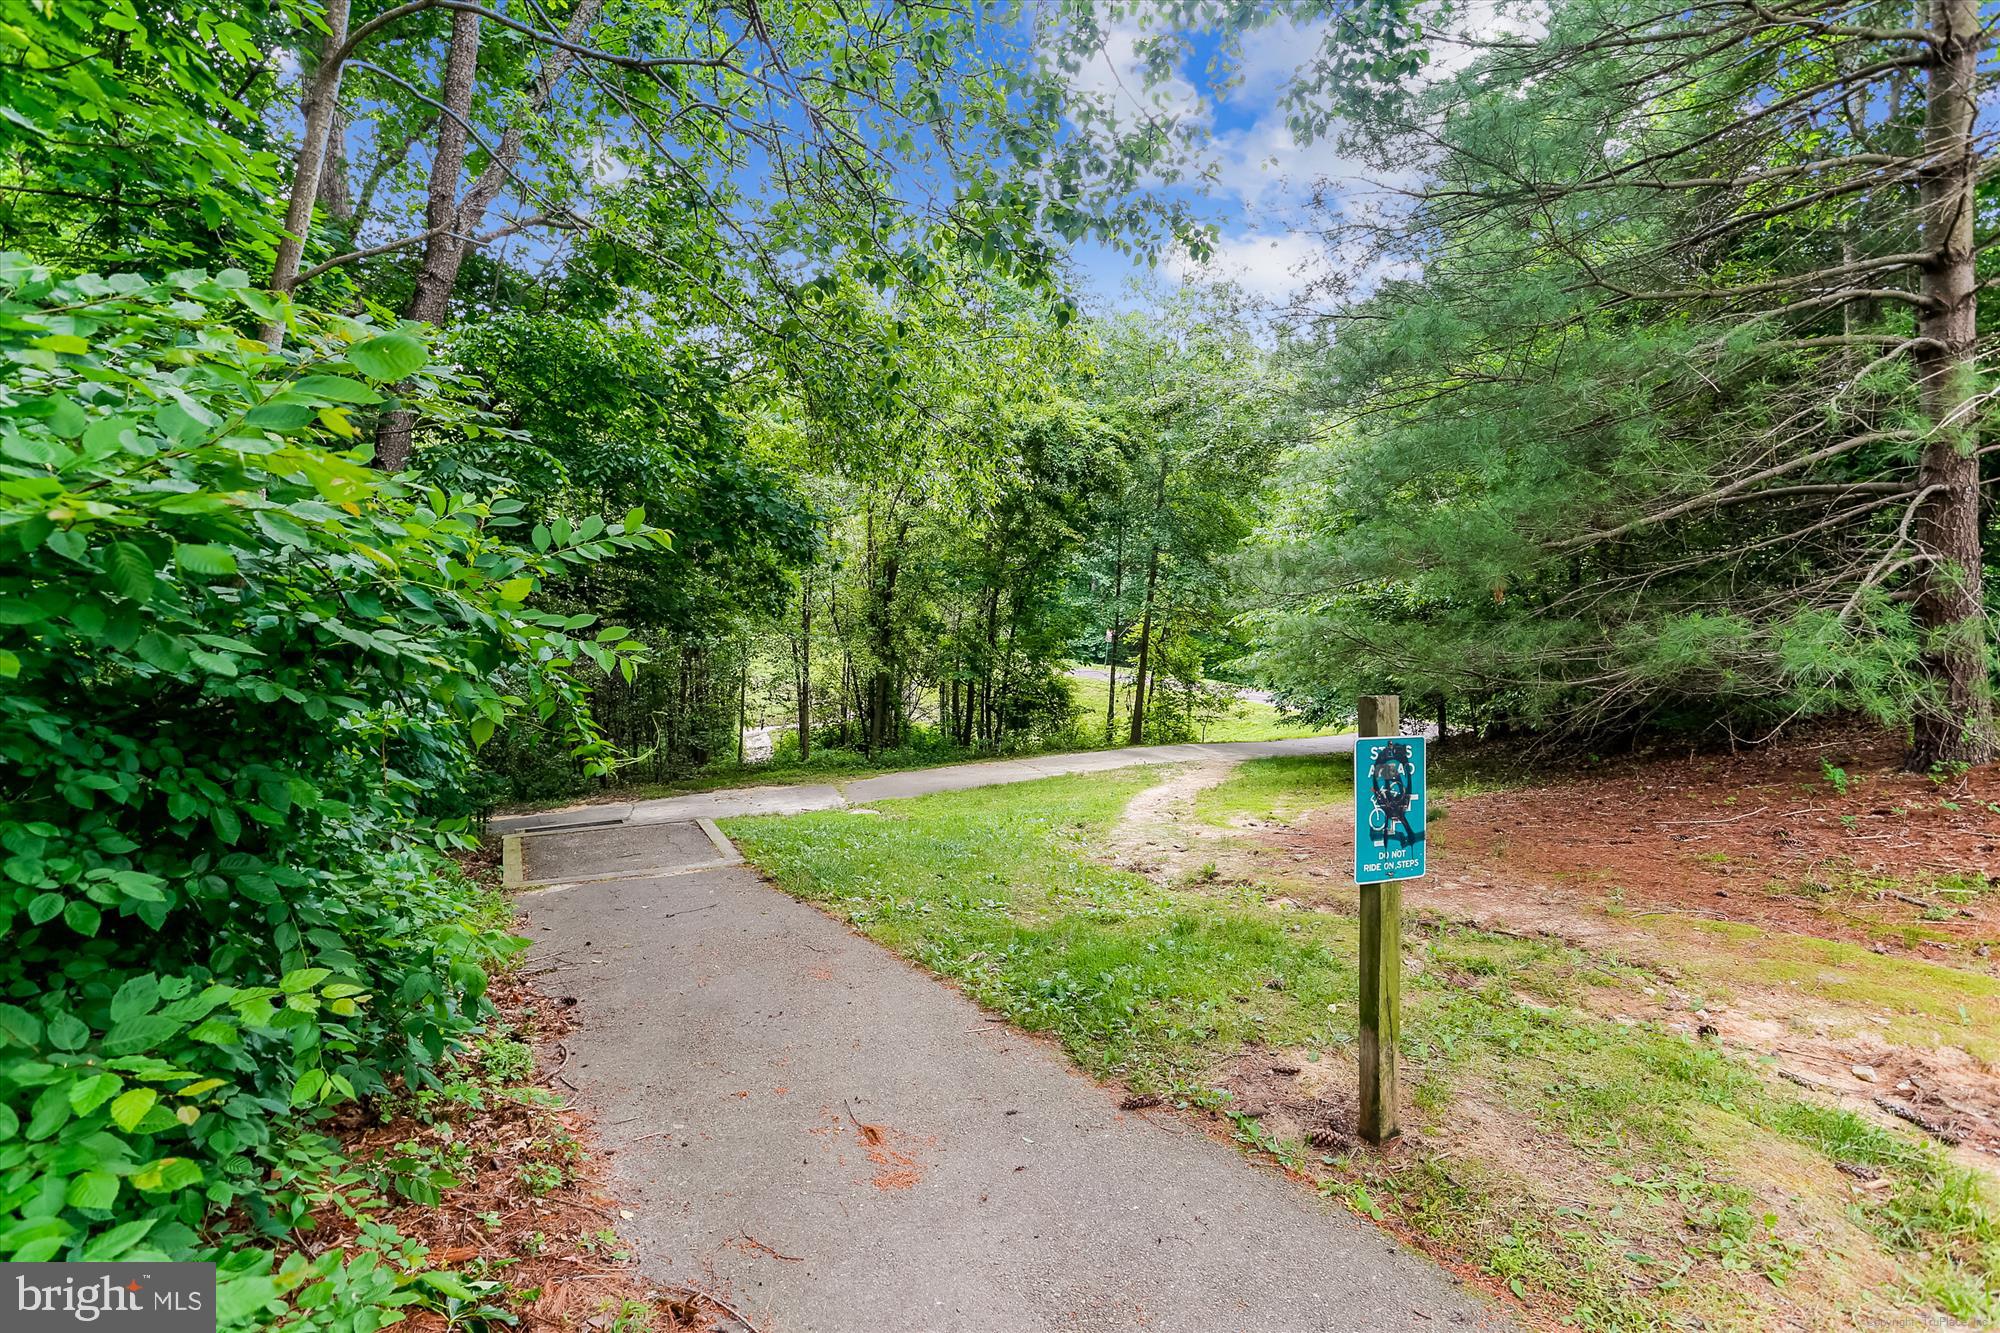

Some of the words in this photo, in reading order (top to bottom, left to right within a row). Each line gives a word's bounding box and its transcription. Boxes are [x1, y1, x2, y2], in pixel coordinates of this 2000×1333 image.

[1378, 851, 1390, 860] DO
[1392, 849, 1406, 859] NOT
[1363, 863, 1382, 872] RIDE
[1384, 861, 1394, 870] ON
[1397, 859, 1419, 868] STEPS
